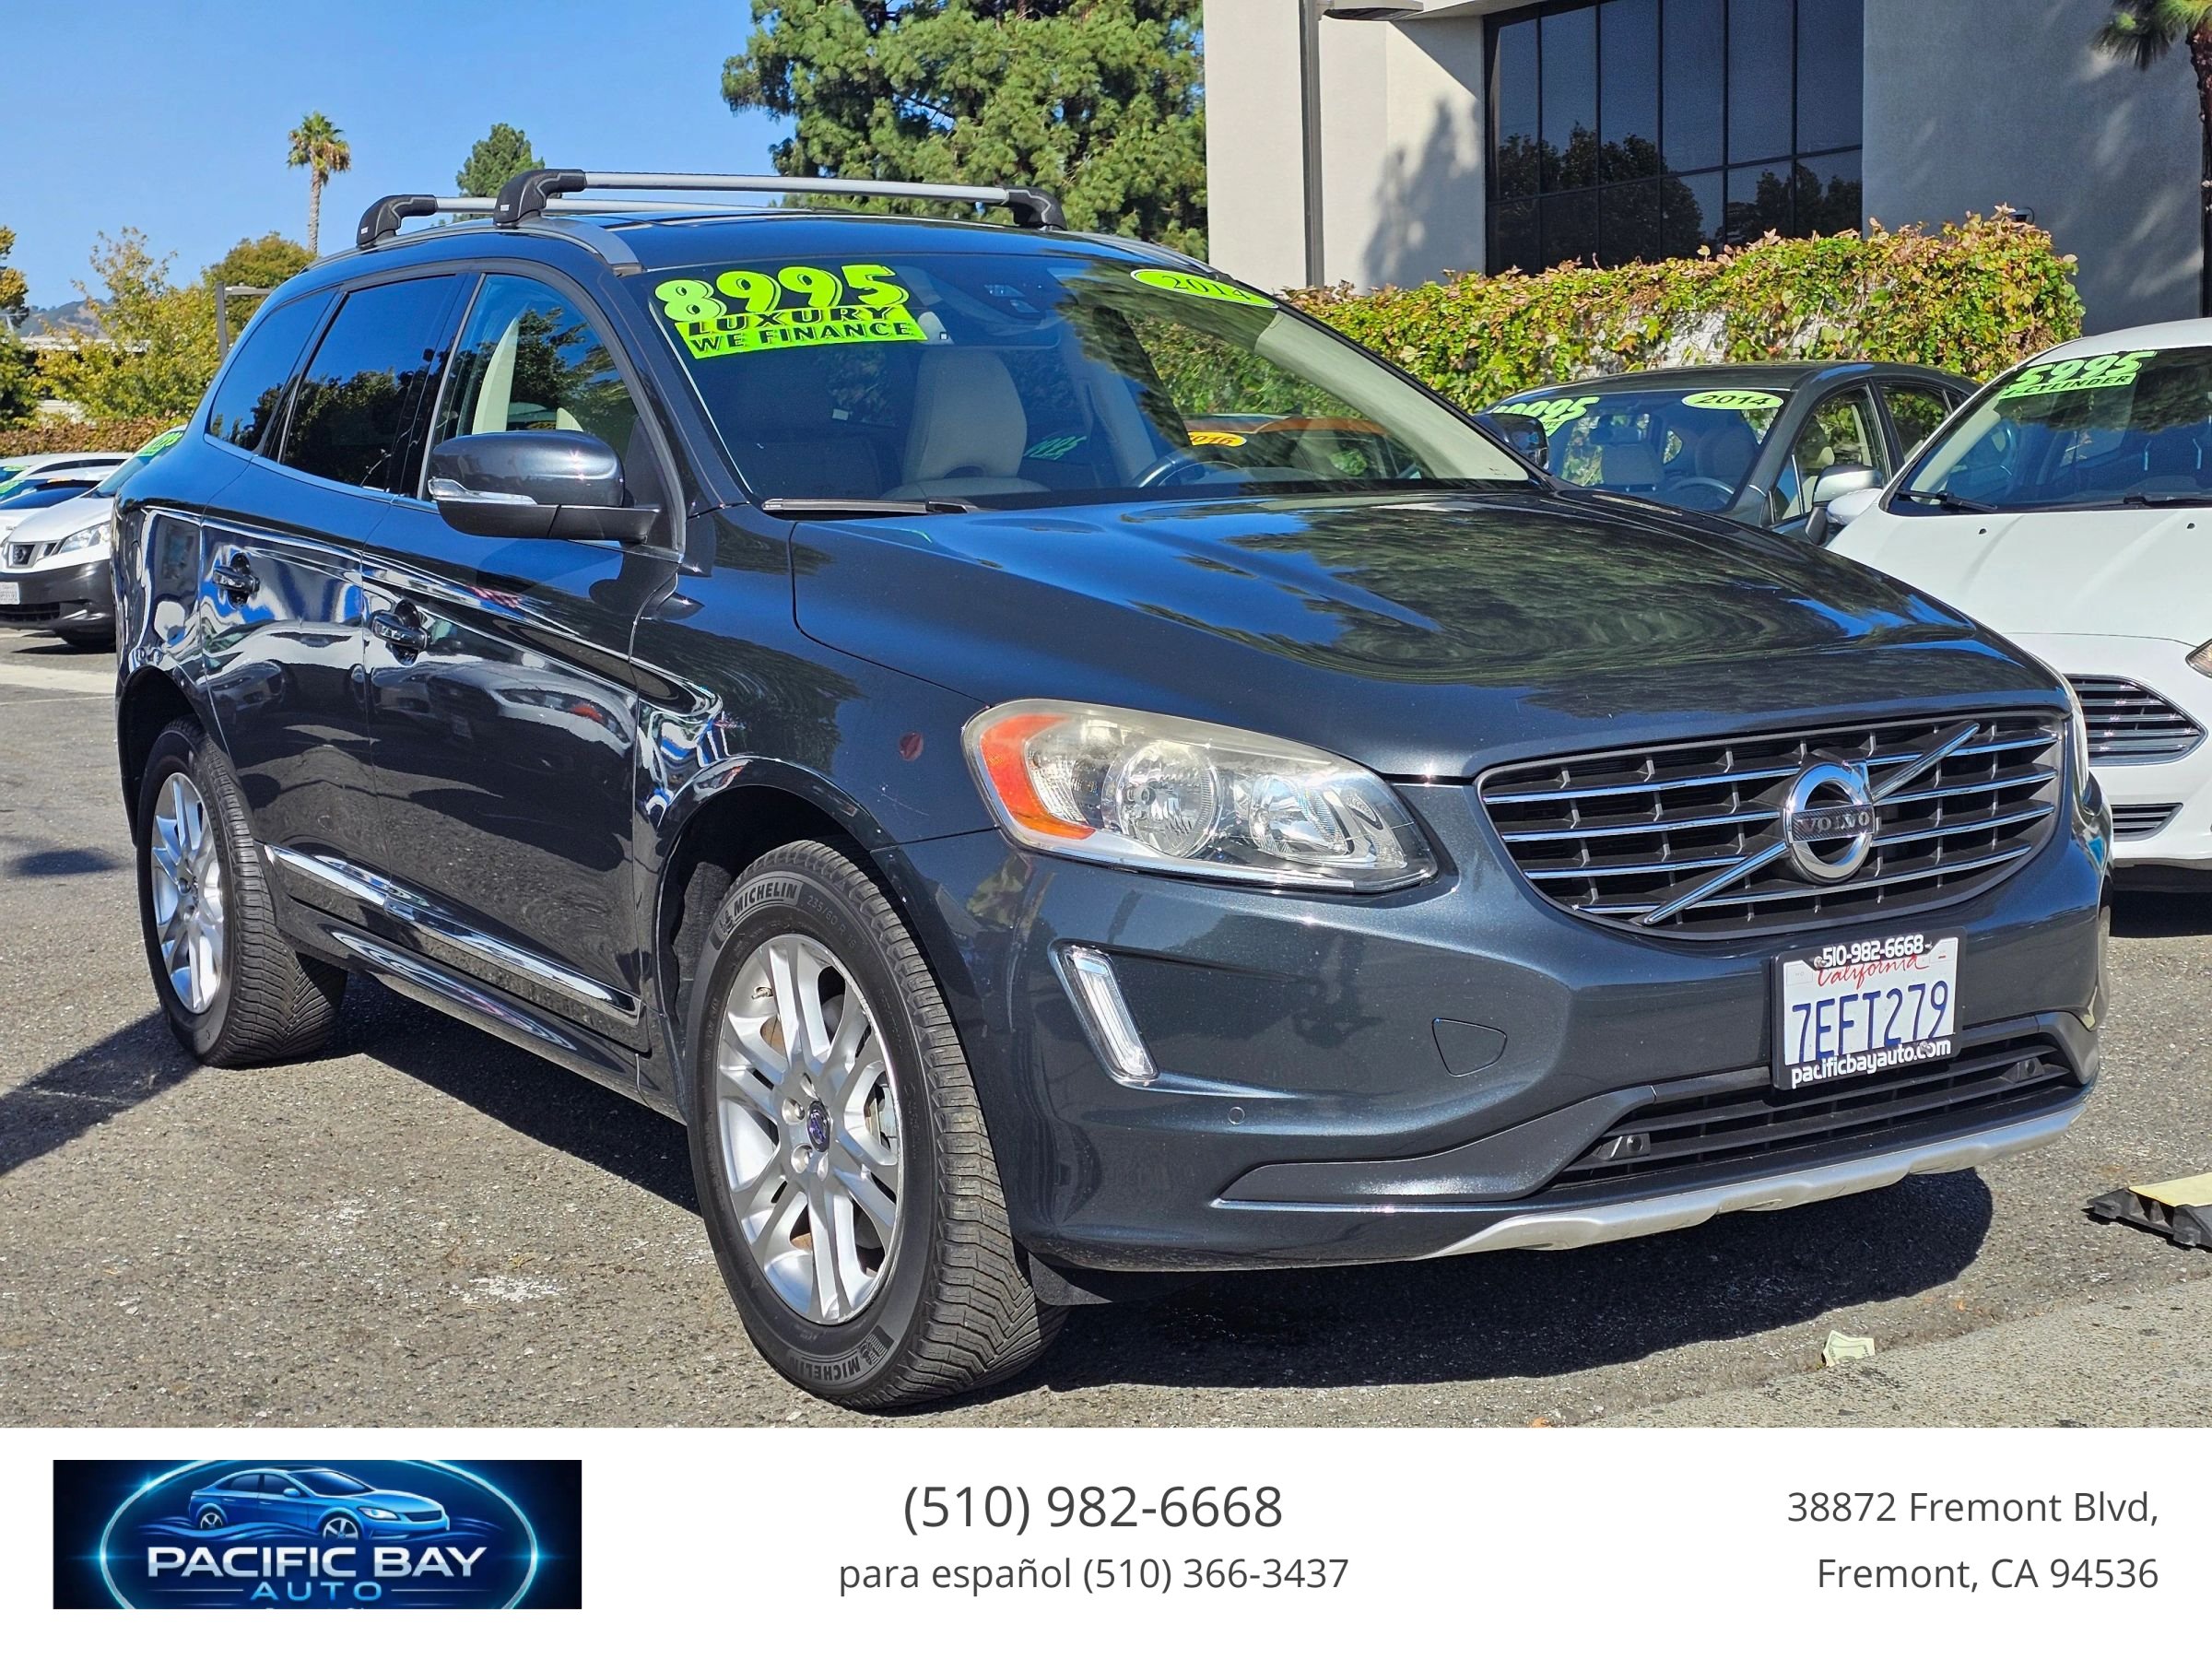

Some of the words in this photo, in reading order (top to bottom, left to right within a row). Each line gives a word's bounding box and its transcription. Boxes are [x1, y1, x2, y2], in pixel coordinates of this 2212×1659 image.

[655, 265, 909, 322] 8995
[1161, 275, 1251, 300] 2014
[688, 306, 892, 336] LUXURY
[689, 332, 747, 352] WE
[759, 322, 916, 344] FINANCE
[2008, 350, 2158, 387] 5995
[1695, 394, 1771, 406] 2014
[1190, 435, 1233, 445] 016
[1797, 812, 1870, 833] VOLVO
[734, 881, 798, 916] MICHELIN
[806, 895, 839, 925] 235/60
[1822, 934, 1924, 967] 510-982-6668
[1816, 953, 1930, 990] California
[1792, 980, 1948, 1063] 7EFT279
[1791, 1039, 1951, 1089] pacificbayauto.com
[789, 1356, 861, 1381] MICHELIN
